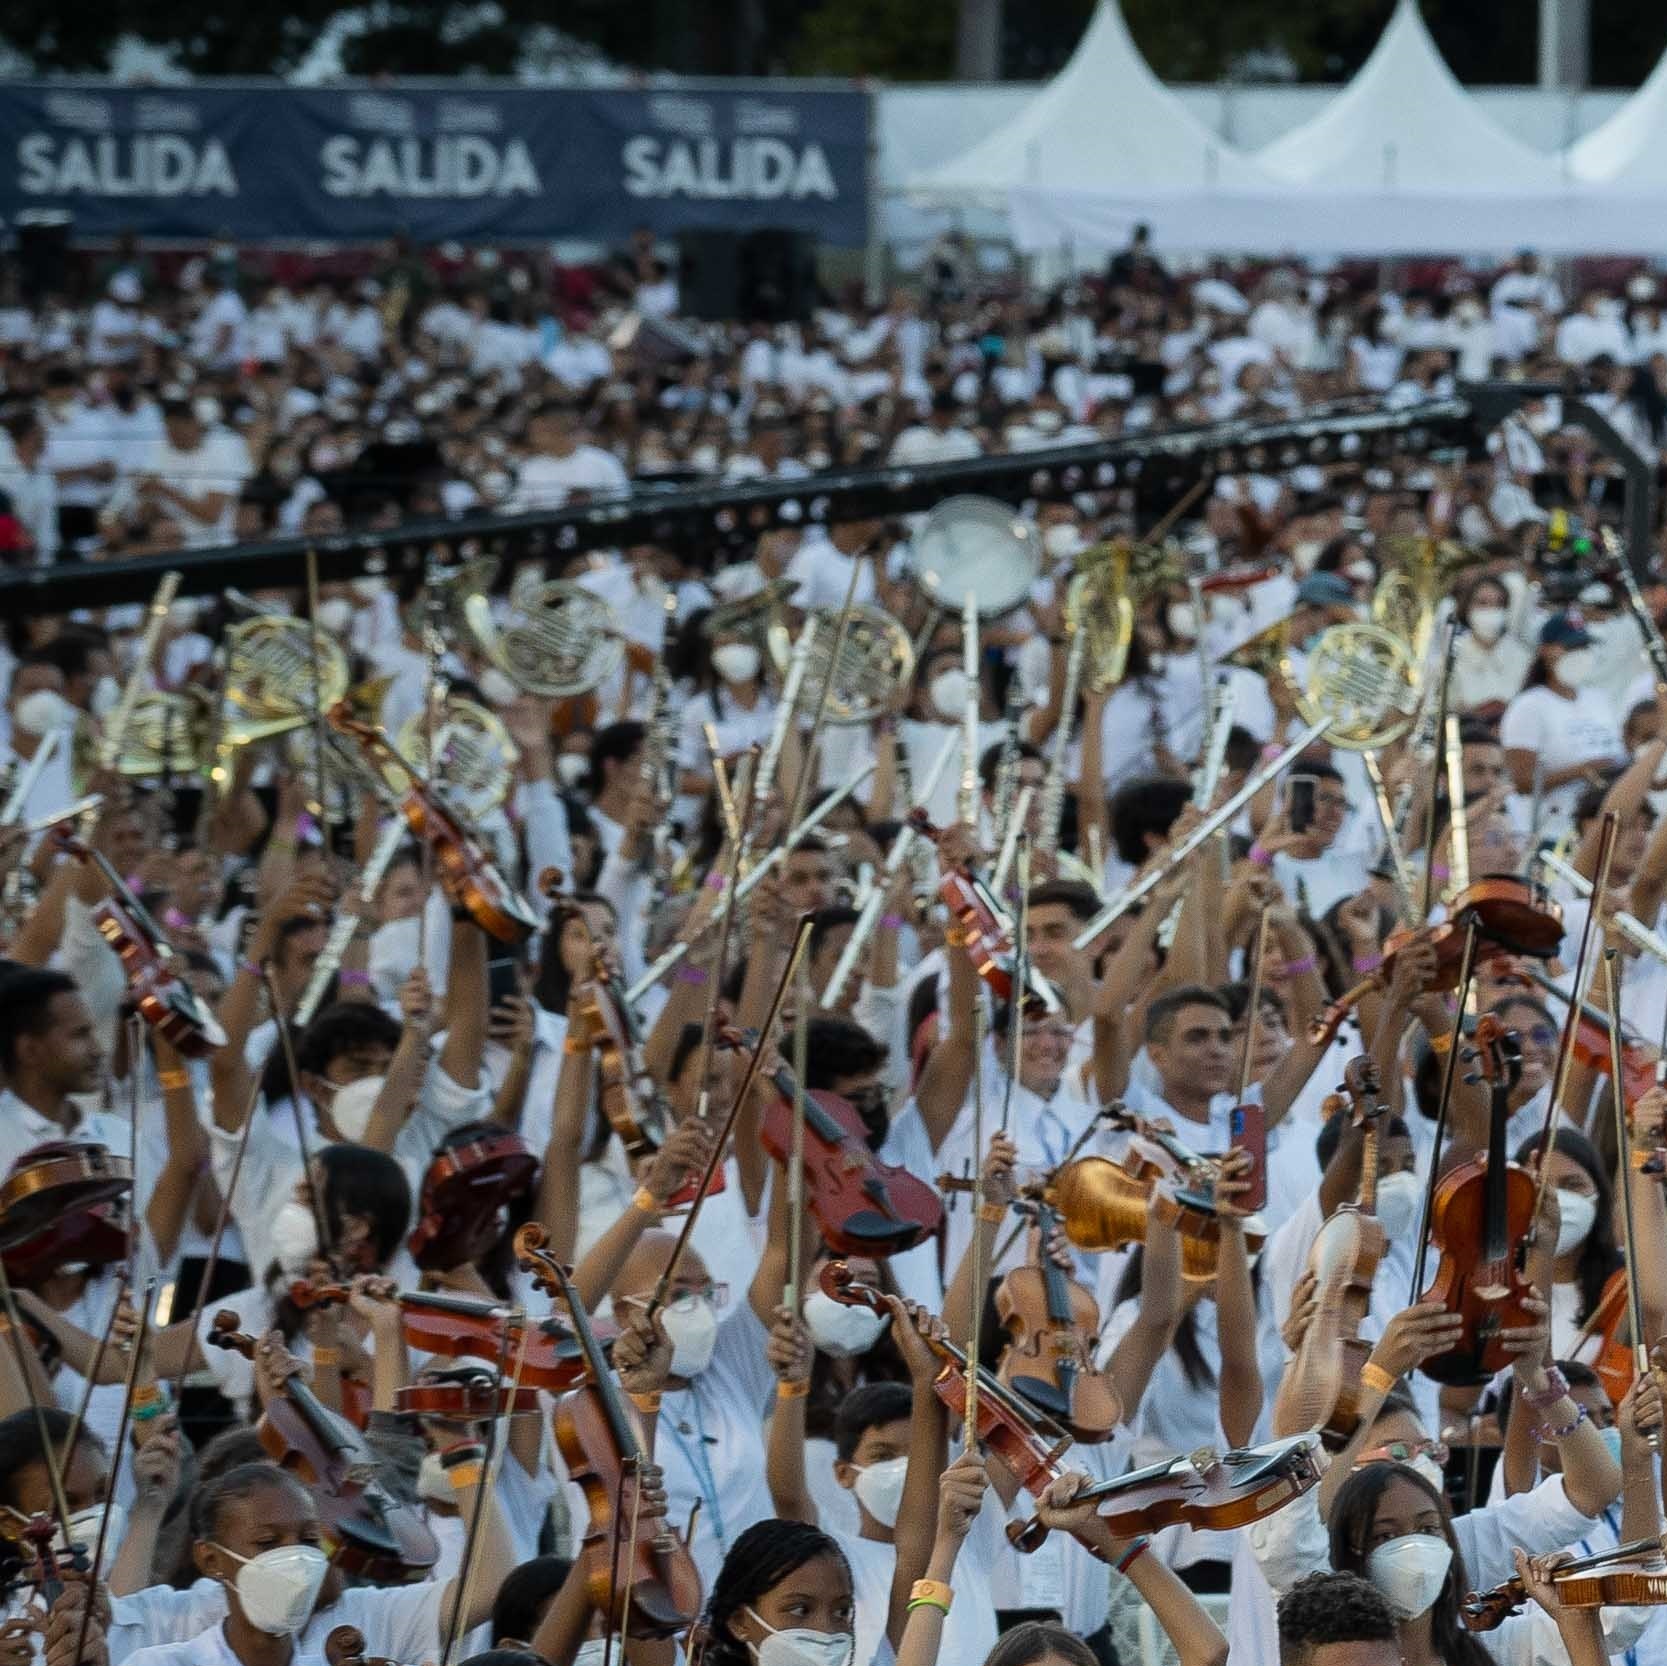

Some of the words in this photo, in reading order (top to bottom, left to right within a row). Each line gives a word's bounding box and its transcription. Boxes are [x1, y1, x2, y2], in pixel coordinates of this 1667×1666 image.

[17, 132, 239, 197] SALIDA
[320, 133, 543, 199] SALIDA
[622, 134, 839, 201] SALIDA
